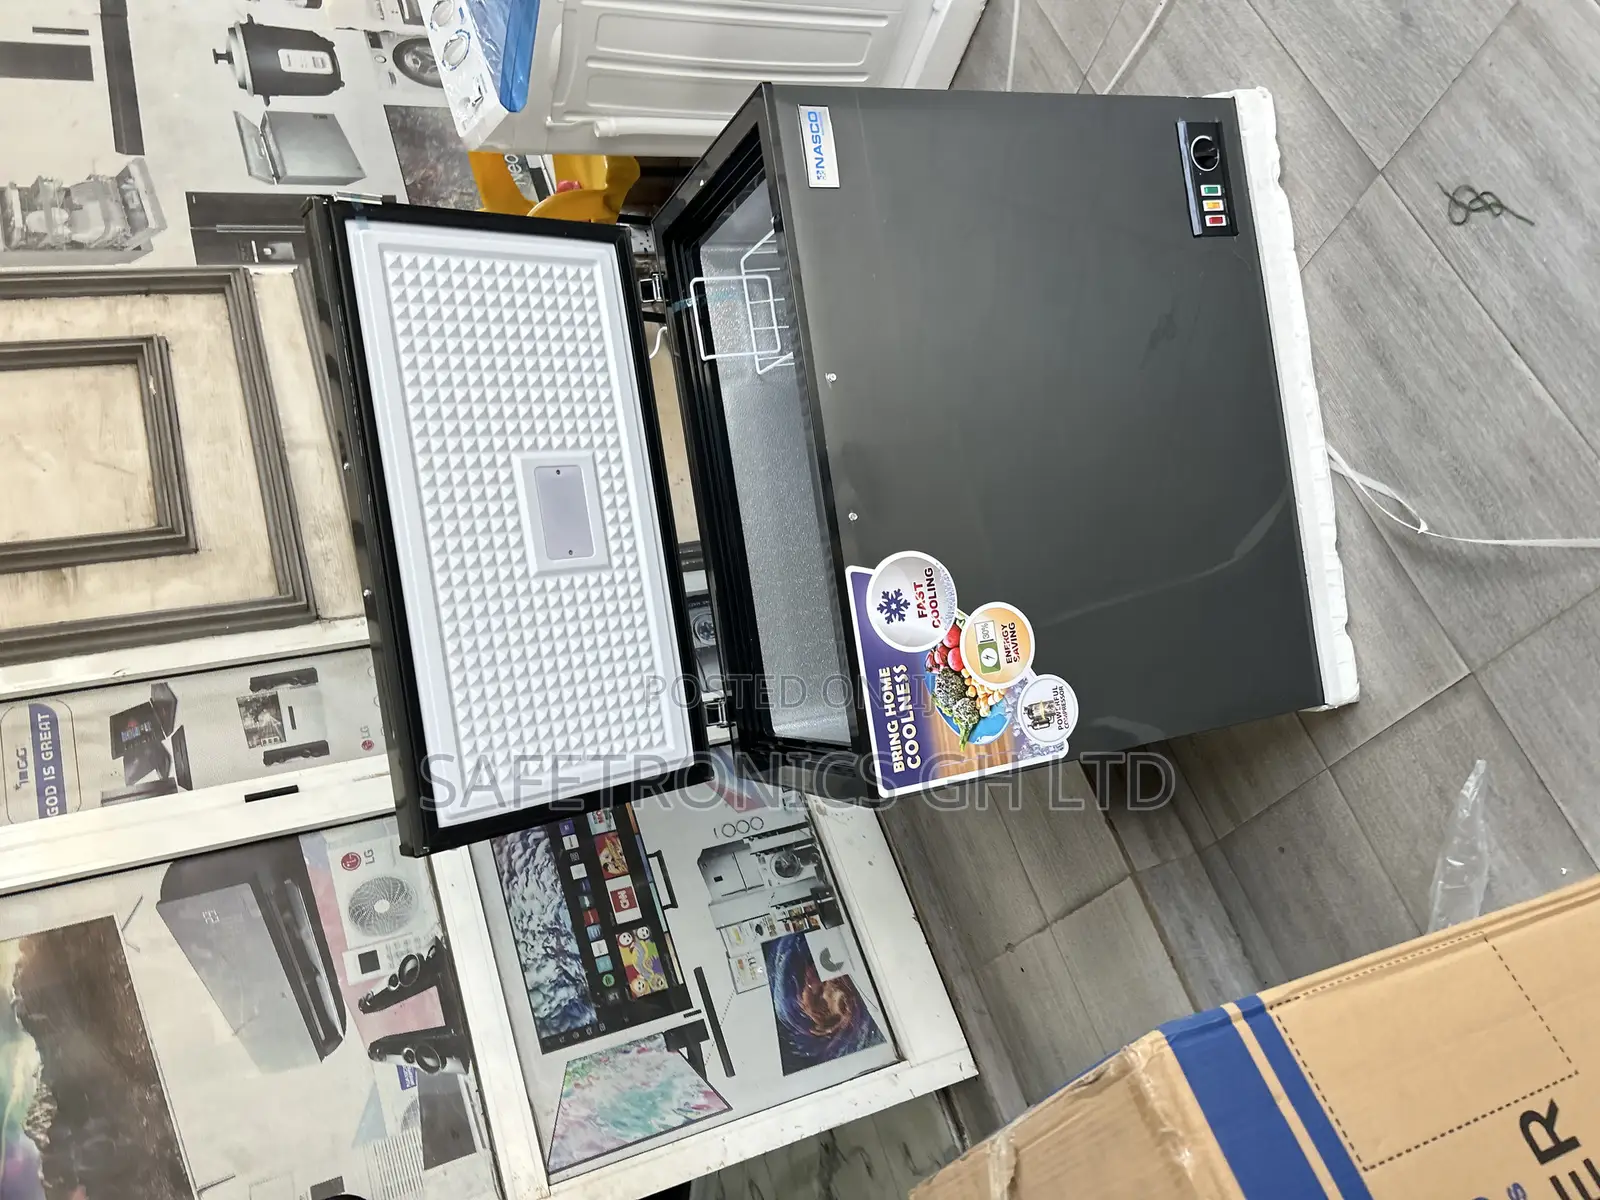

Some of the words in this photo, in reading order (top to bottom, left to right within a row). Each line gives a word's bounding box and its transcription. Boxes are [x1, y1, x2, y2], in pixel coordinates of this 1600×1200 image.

[807, 111, 825, 169] NASCO
[913, 582, 928, 619] FAST
[924, 567, 941, 629] COOLING
[980, 622, 990, 640] 30%
[1000, 623, 1013, 665] ENERGY
[1008, 622, 1021, 663] SAVING
[878, 666, 900, 718] HOME
[1052, 684, 1065, 731] POWERFUL
[1059, 685, 1070, 730] COMPRESSOR
[37, 713, 54, 761] GREAT
[892, 664, 922, 770] COOLNESS
[886, 721, 906, 774] BRING
[42, 765, 56, 781] IS
[45, 785, 59, 817] GOD
[363, 849, 375, 866] LG
